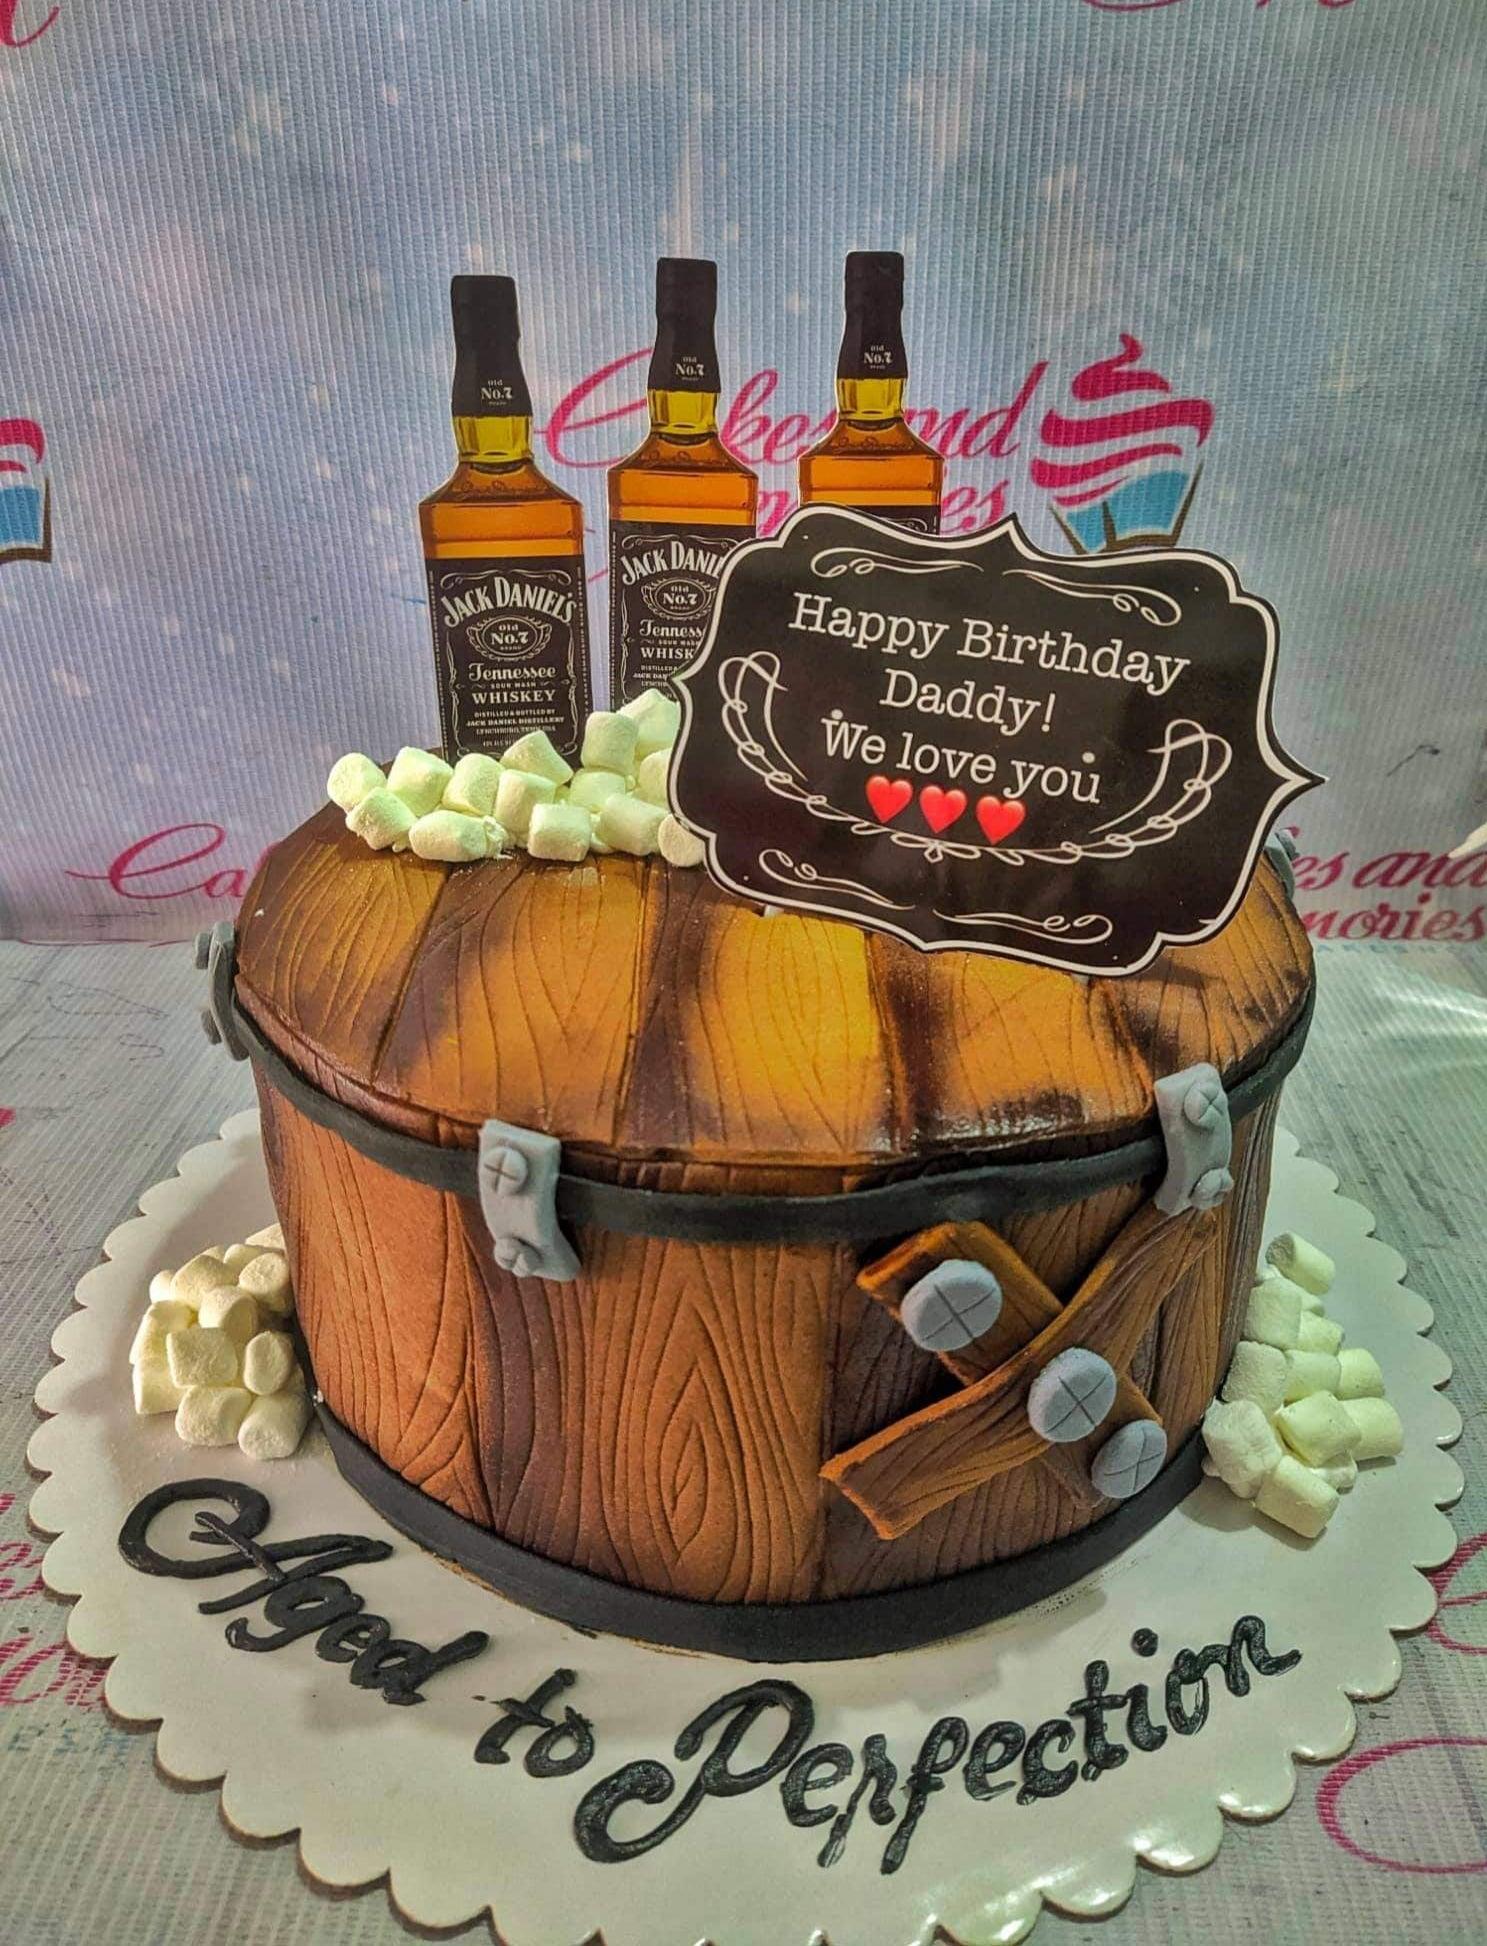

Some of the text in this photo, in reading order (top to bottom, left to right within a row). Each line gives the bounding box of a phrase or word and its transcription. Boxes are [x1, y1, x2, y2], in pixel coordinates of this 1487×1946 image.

[863, 352, 893, 364] No.7
[675, 363, 704, 376] No.7
[481, 387, 513, 400] No.7
[620, 548, 669, 586] JACK
[440, 576, 577, 628] JACK DANIEL'S
[663, 591, 698, 605] No.7
[499, 623, 519, 632] Old
[639, 618, 703, 638] Tenness
[490, 630, 529, 646] No.7
[788, 592, 1191, 697] Happy Birthday
[640, 646, 695, 660] WHISK
[468, 662, 557, 682] Tennessee
[471, 689, 557, 706] WHISKEY
[879, 668, 1057, 737] Daddy!
[820, 716, 1101, 804] We love you
[118, 1477, 490, 1706] Aged
[472, 1667, 594, 1779] to
[573, 1614, 1303, 1876] Perfection
